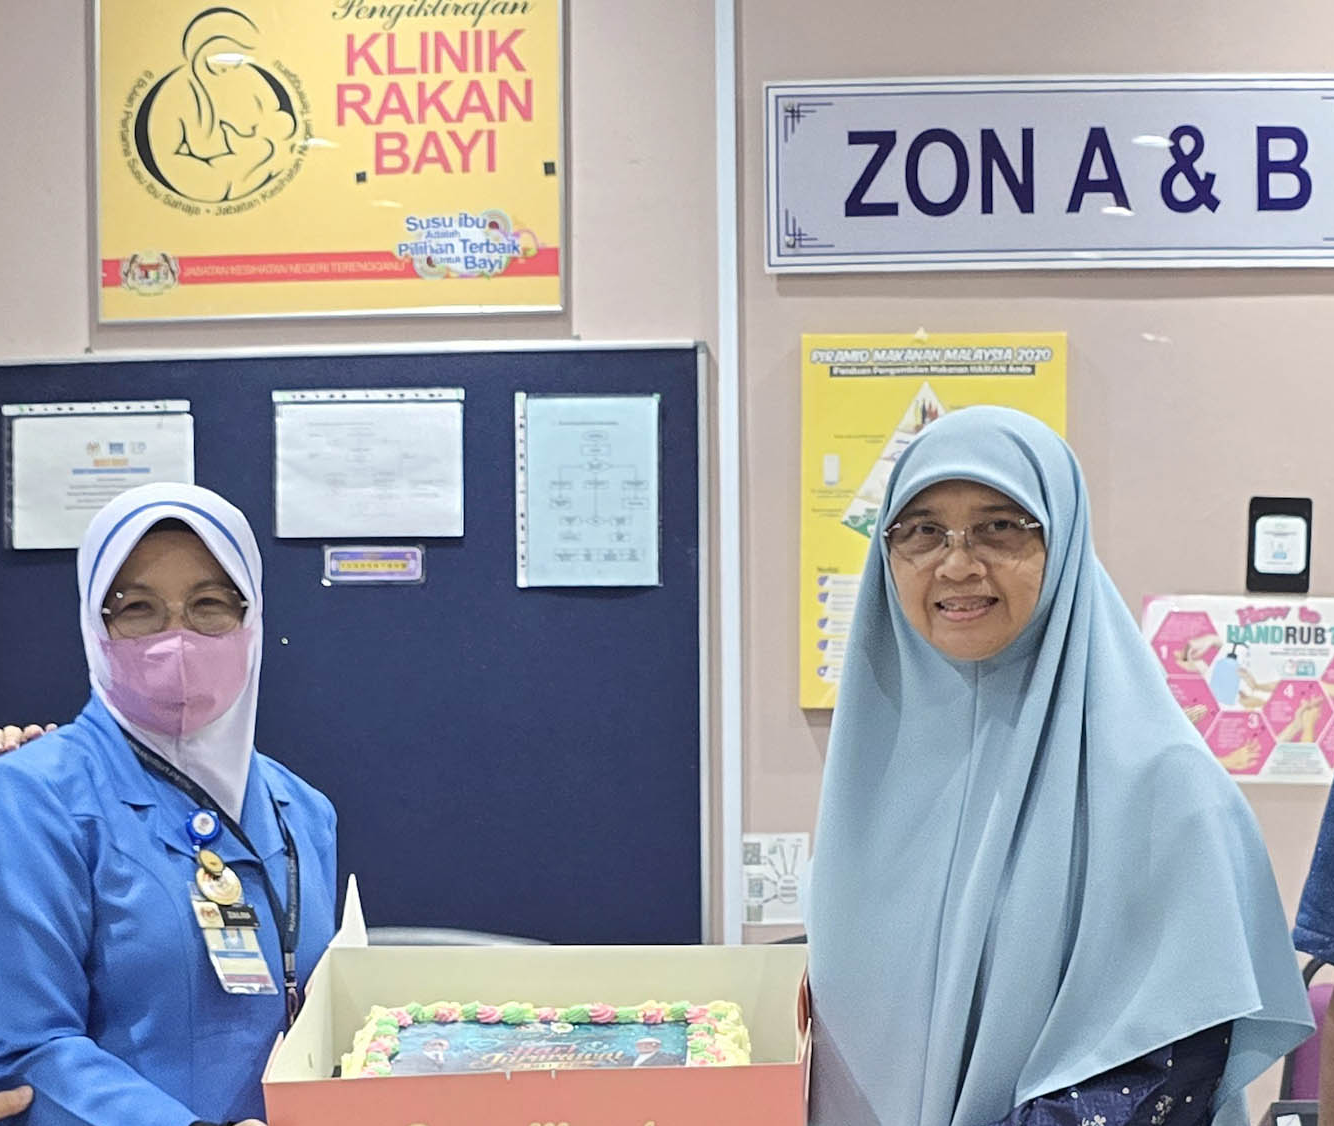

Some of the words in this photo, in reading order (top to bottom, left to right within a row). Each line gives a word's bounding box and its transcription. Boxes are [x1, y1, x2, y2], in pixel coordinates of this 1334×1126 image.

[346, 29, 527, 76] KLINIK
[336, 78, 534, 127] RAKAN
[375, 129, 496, 175] BAYI
[844, 127, 1035, 217] ZON
[1066, 126, 1131, 213] A
[1160, 124, 1221, 213] &
[1256, 125, 1313, 212] B
[406, 216, 453, 231] Susu
[459, 213, 487, 229] ibu
[398, 241, 454, 256] Pilihan
[460, 239, 520, 254] Terbaik
[464, 256, 502, 272] Bayi
[872, 348, 940, 362] MAKANAN
[944, 348, 1012, 362] MALAYSIA
[1236, 606, 1290, 626] How
